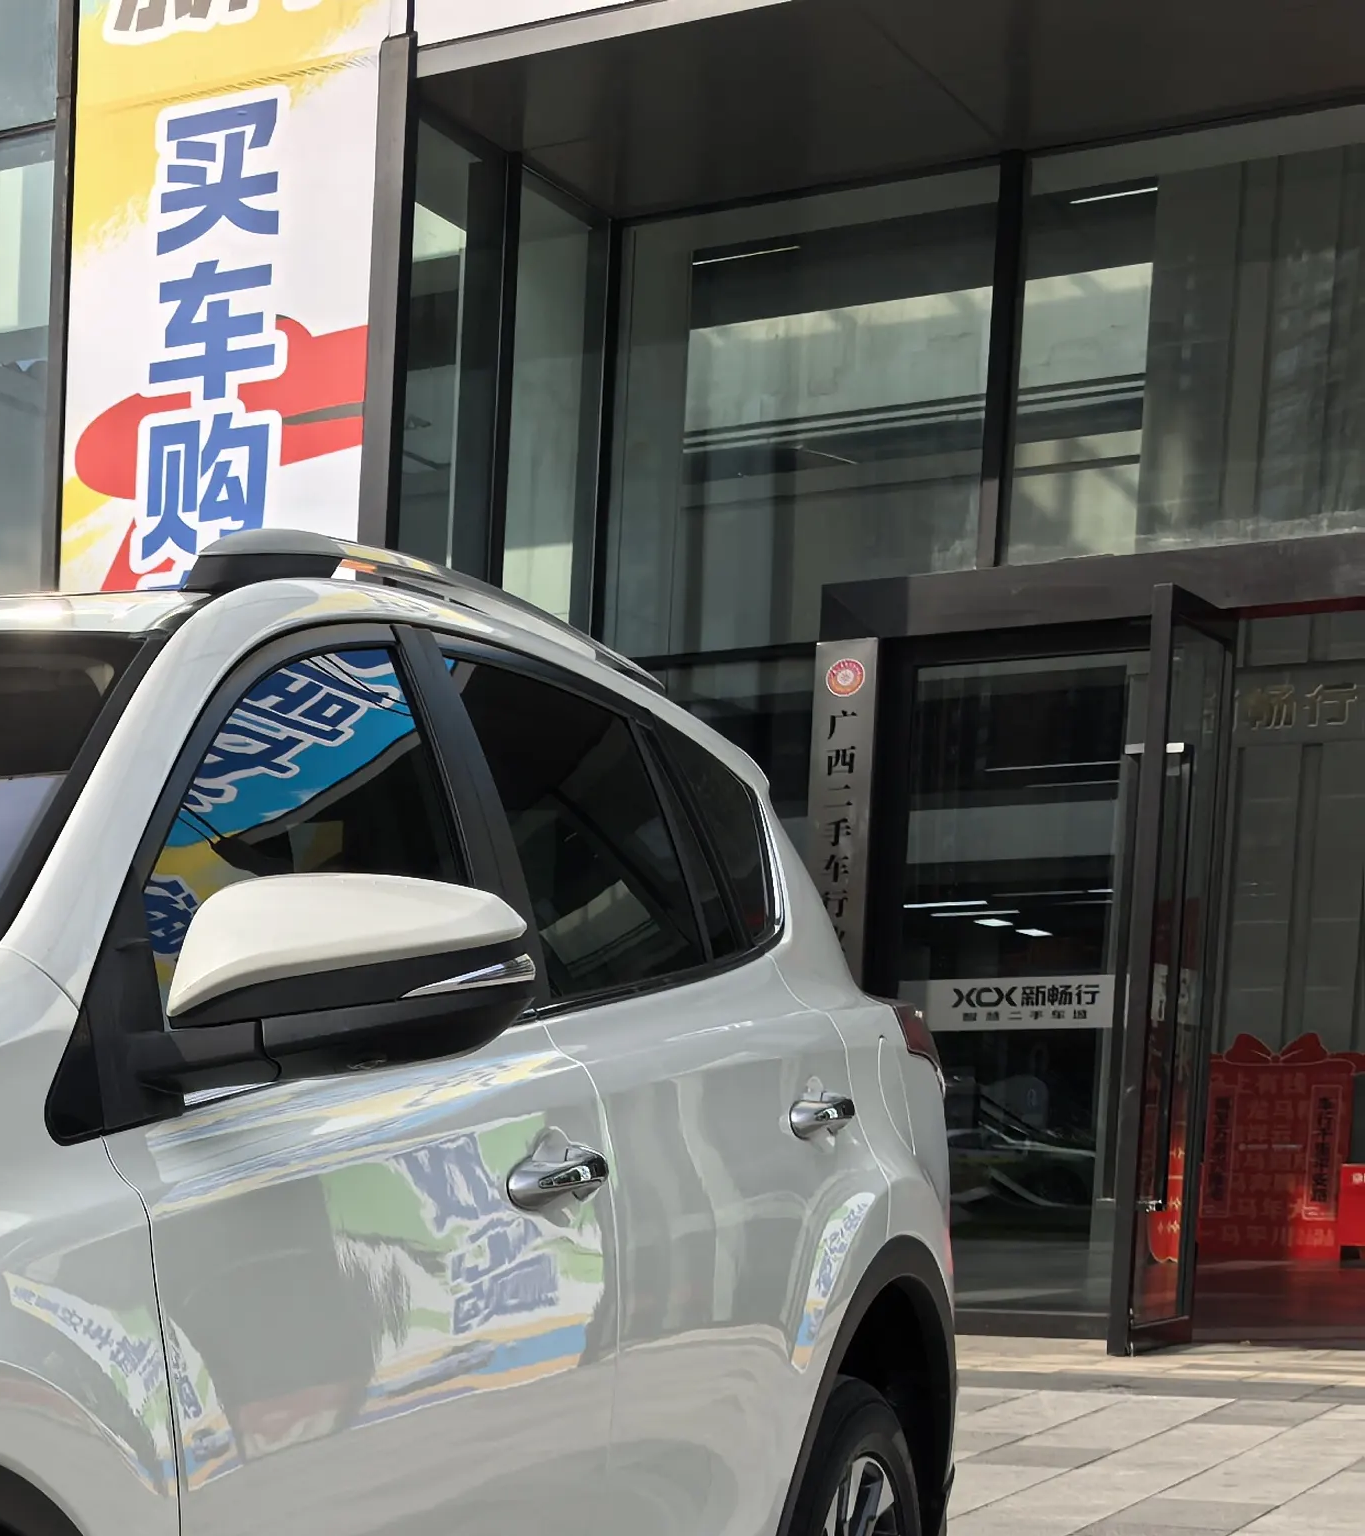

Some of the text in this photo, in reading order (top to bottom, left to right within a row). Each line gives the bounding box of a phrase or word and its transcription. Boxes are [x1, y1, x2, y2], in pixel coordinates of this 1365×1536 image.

[142, 98, 280, 590] 买车购
[1021, 984, 1101, 1007] 新畅行
